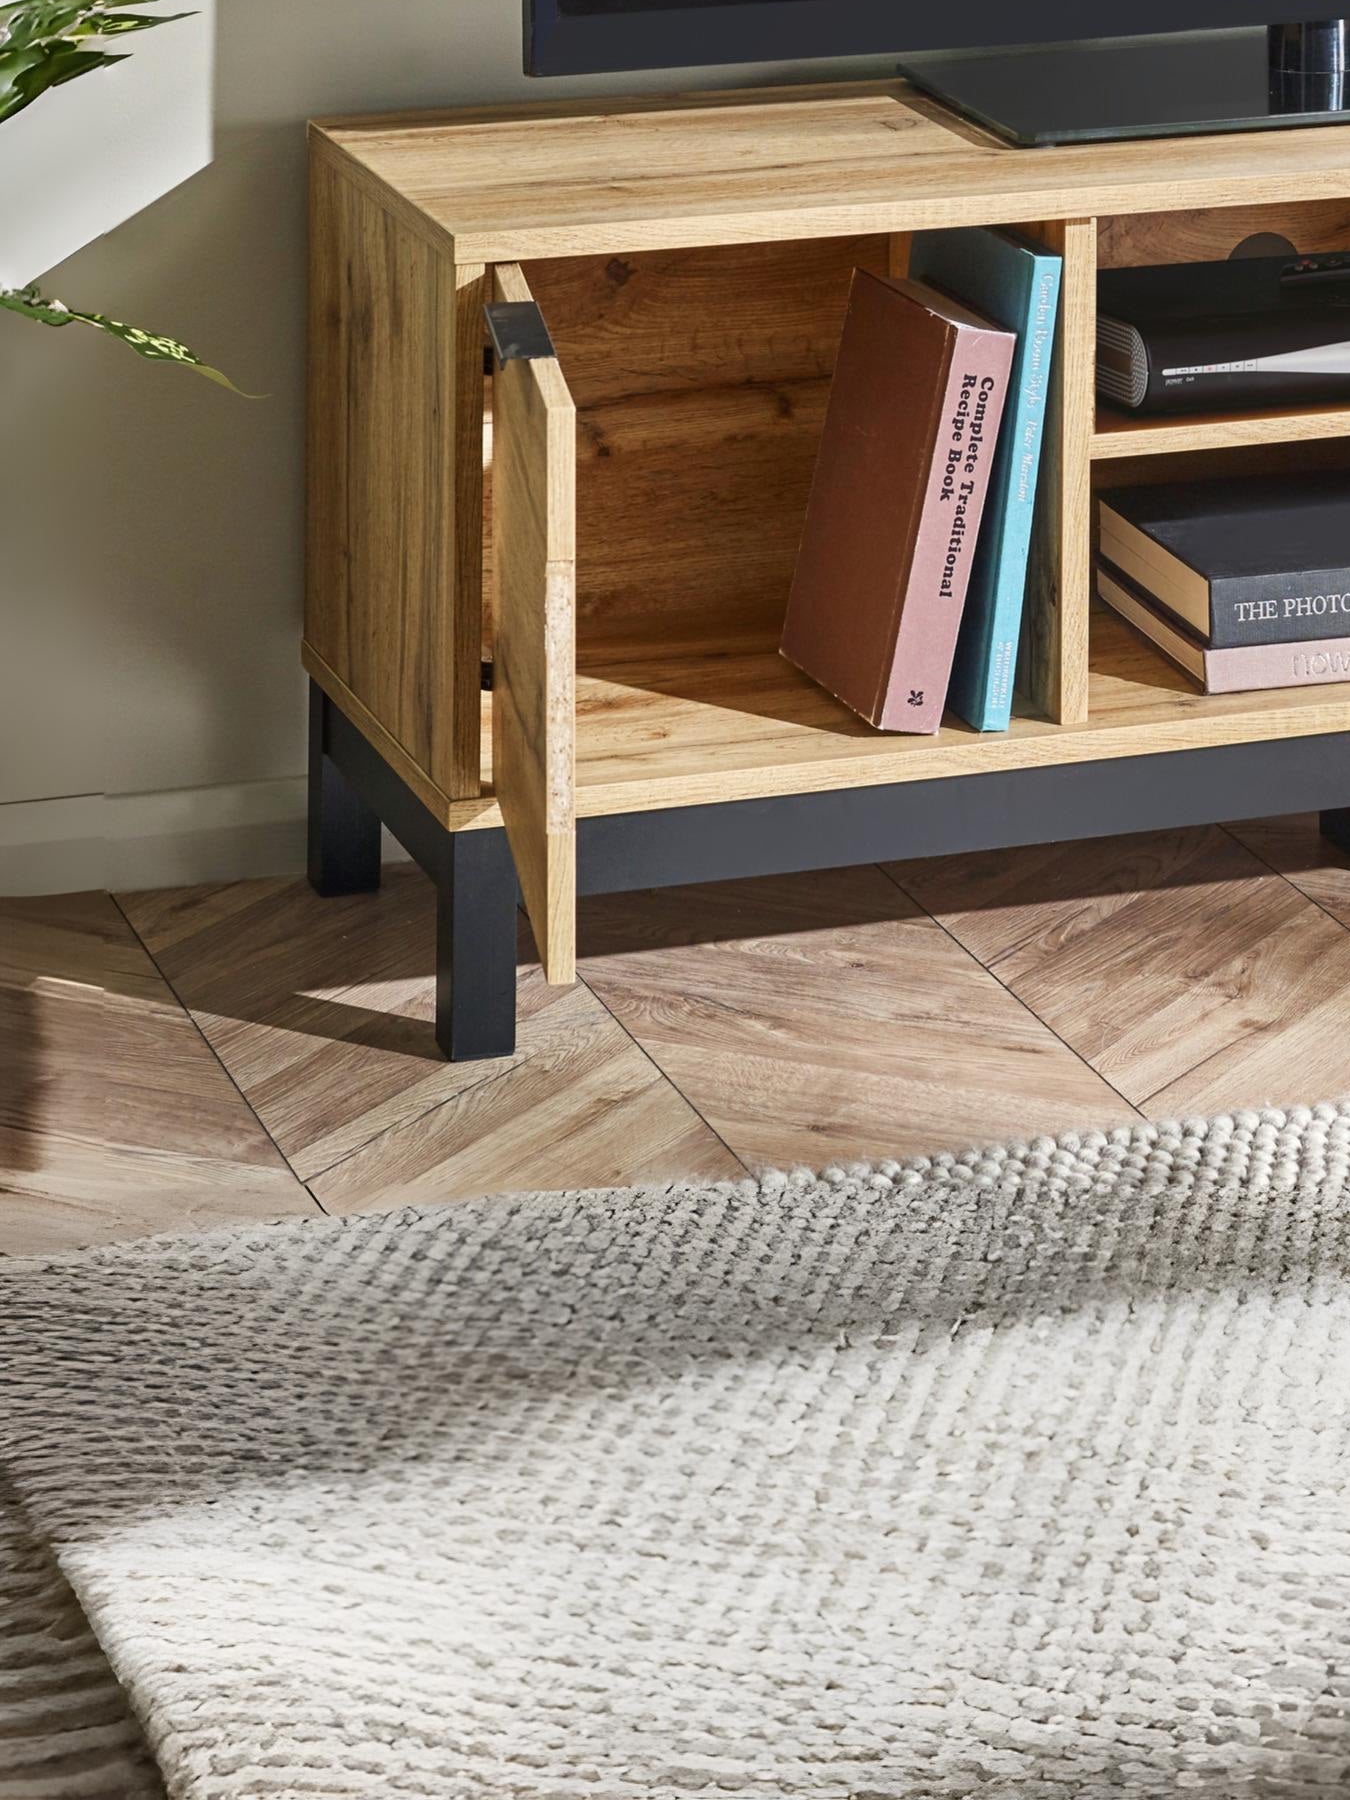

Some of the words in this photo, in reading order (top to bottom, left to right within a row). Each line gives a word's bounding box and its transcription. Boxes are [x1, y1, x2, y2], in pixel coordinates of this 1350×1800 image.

[952, 374, 977, 442] Recipe
[964, 376, 994, 474] Complete
[939, 449, 962, 502] Book
[939, 480, 974, 598] Traditional
[1234, 600, 1278, 622] THE
